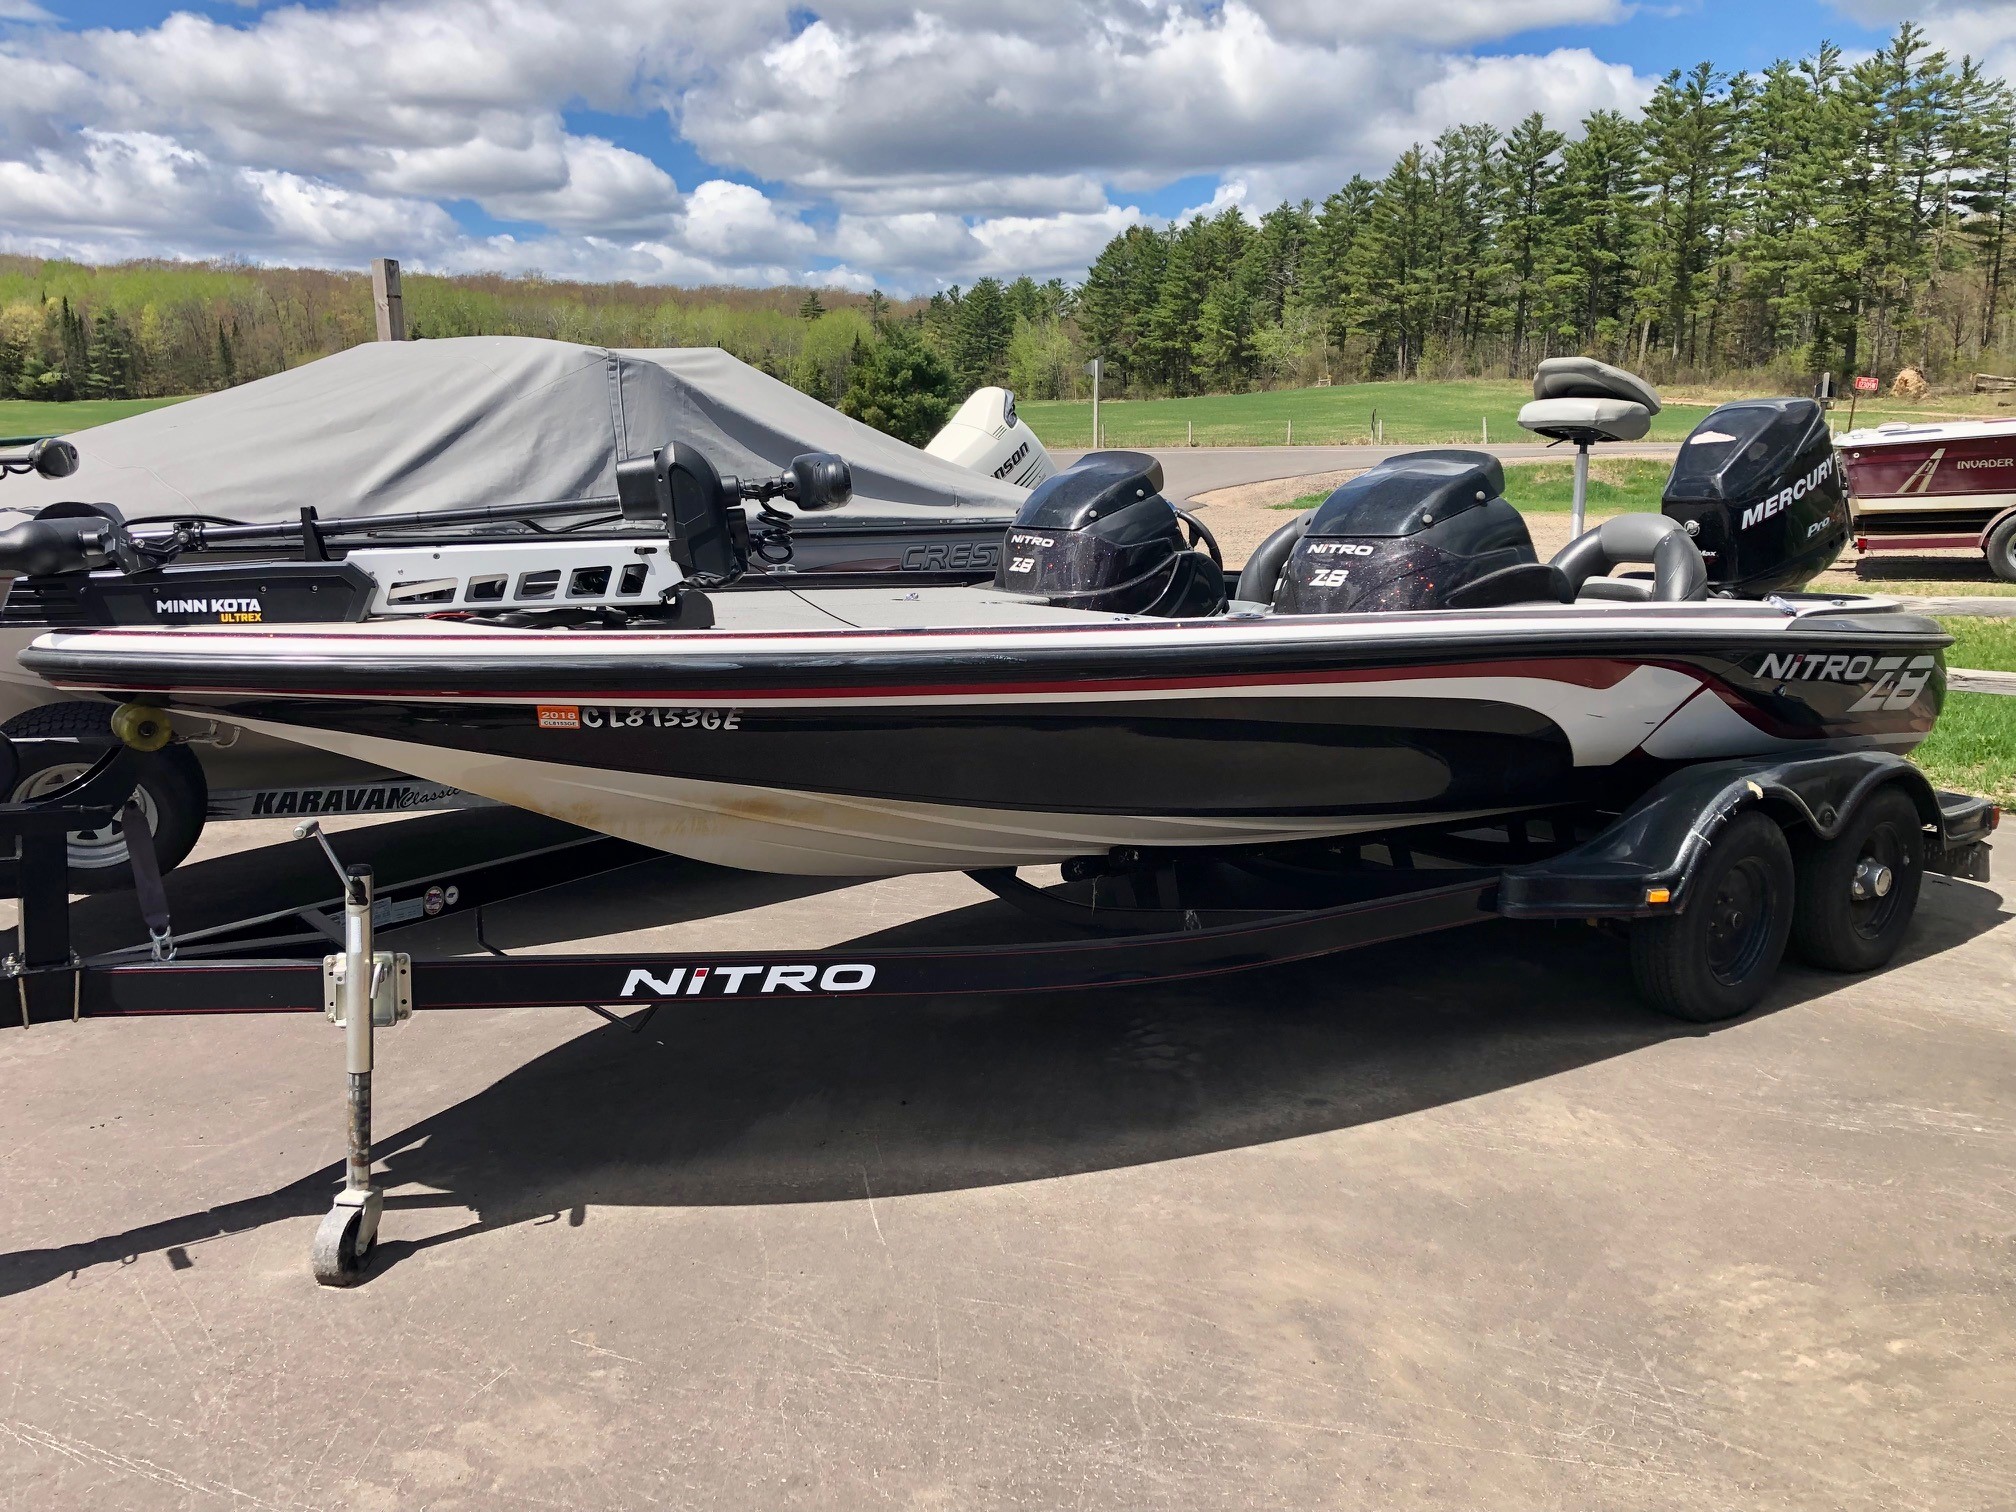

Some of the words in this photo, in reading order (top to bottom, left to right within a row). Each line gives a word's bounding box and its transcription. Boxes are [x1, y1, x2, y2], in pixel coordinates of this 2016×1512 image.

[1957, 458, 2014, 470] INVADER
[1741, 453, 1834, 531] MERCURY
[1807, 516, 1830, 538] Pro
[1010, 534, 1055, 548] NITRO
[1306, 543, 1374, 556] NITRO
[1009, 557, 1035, 573] Z8
[1309, 569, 1350, 587] Z8
[156, 599, 208, 613] MINN
[211, 598, 262, 612] KOTA
[220, 613, 262, 623] ULTREX
[1753, 653, 1874, 681] NITRO
[1845, 655, 1936, 713] Z8
[541, 711, 576, 719] 2018
[251, 787, 411, 815] KARAVAN
[400, 786, 461, 808] Classic
[620, 964, 876, 996] NITRO
